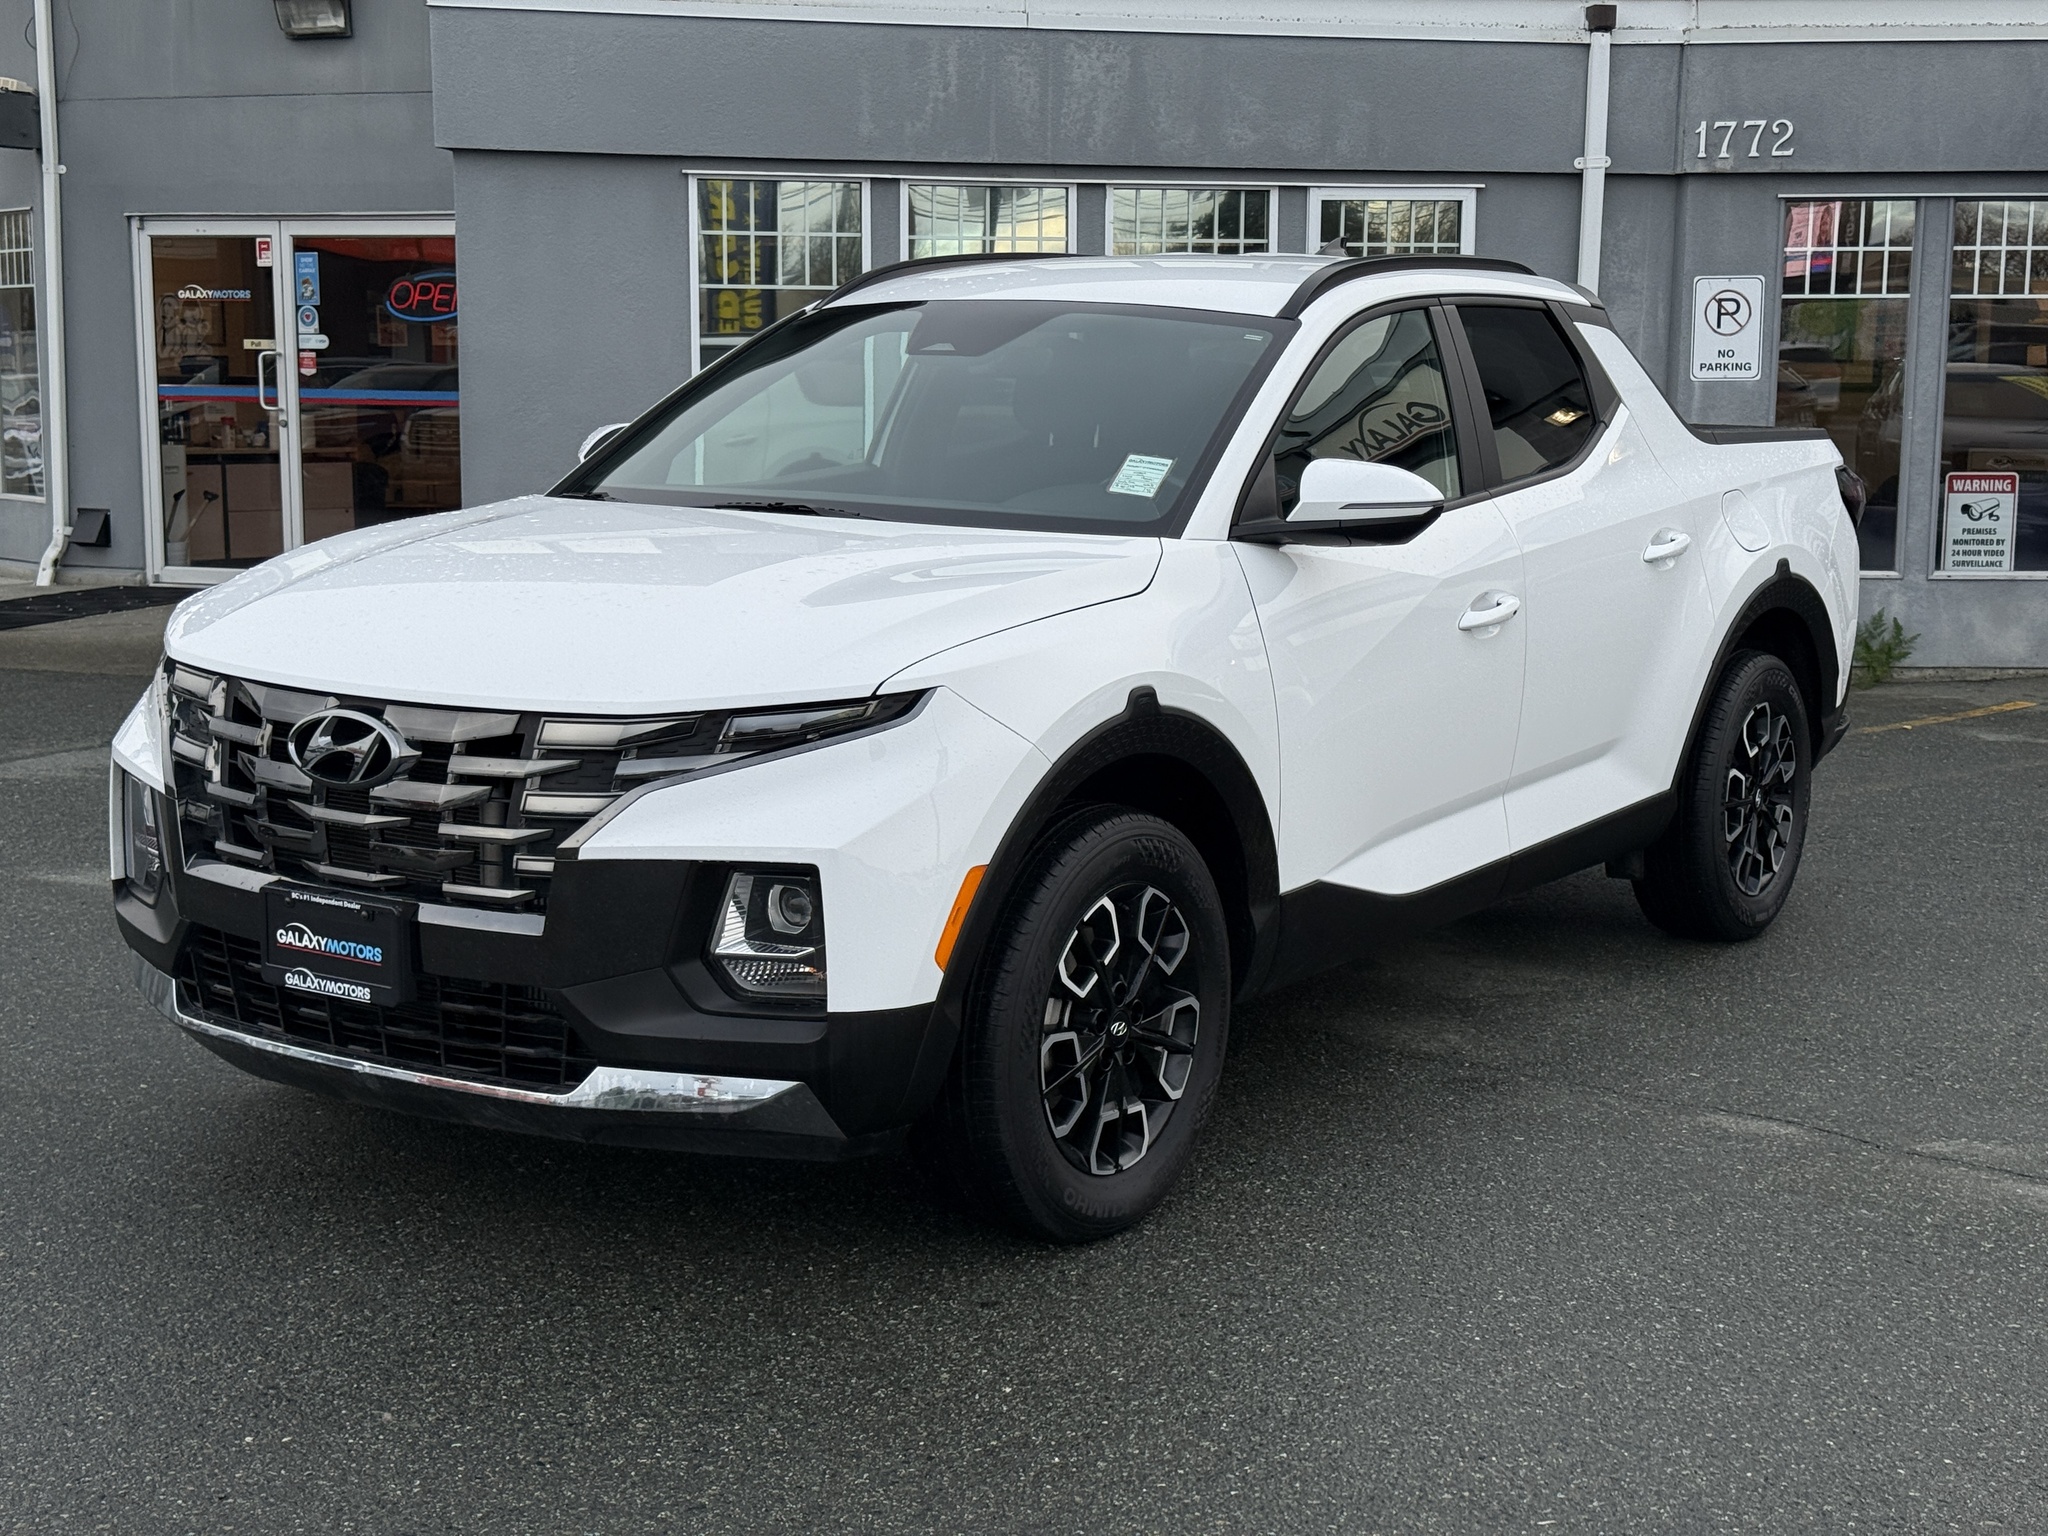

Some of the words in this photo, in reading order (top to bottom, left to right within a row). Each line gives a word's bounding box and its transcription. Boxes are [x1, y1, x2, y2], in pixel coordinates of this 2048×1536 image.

[1694, 119, 1795, 158] 1772
[390, 281, 458, 312] OPE
[1717, 349, 1735, 359] NO
[1699, 362, 1752, 372] PARKING
[1952, 479, 2012, 492] WARNING
[1952, 538, 1995, 546] MONITORED
[1995, 538, 2006, 546] BY
[1951, 549, 1960, 557] 24
[1961, 549, 1982, 557] HOUR
[1983, 549, 2005, 557] VIDEO
[1951, 560, 2003, 568] SURVEILLANCE
[310, 895, 343, 906] Independent
[343, 901, 361, 910] Dealer
